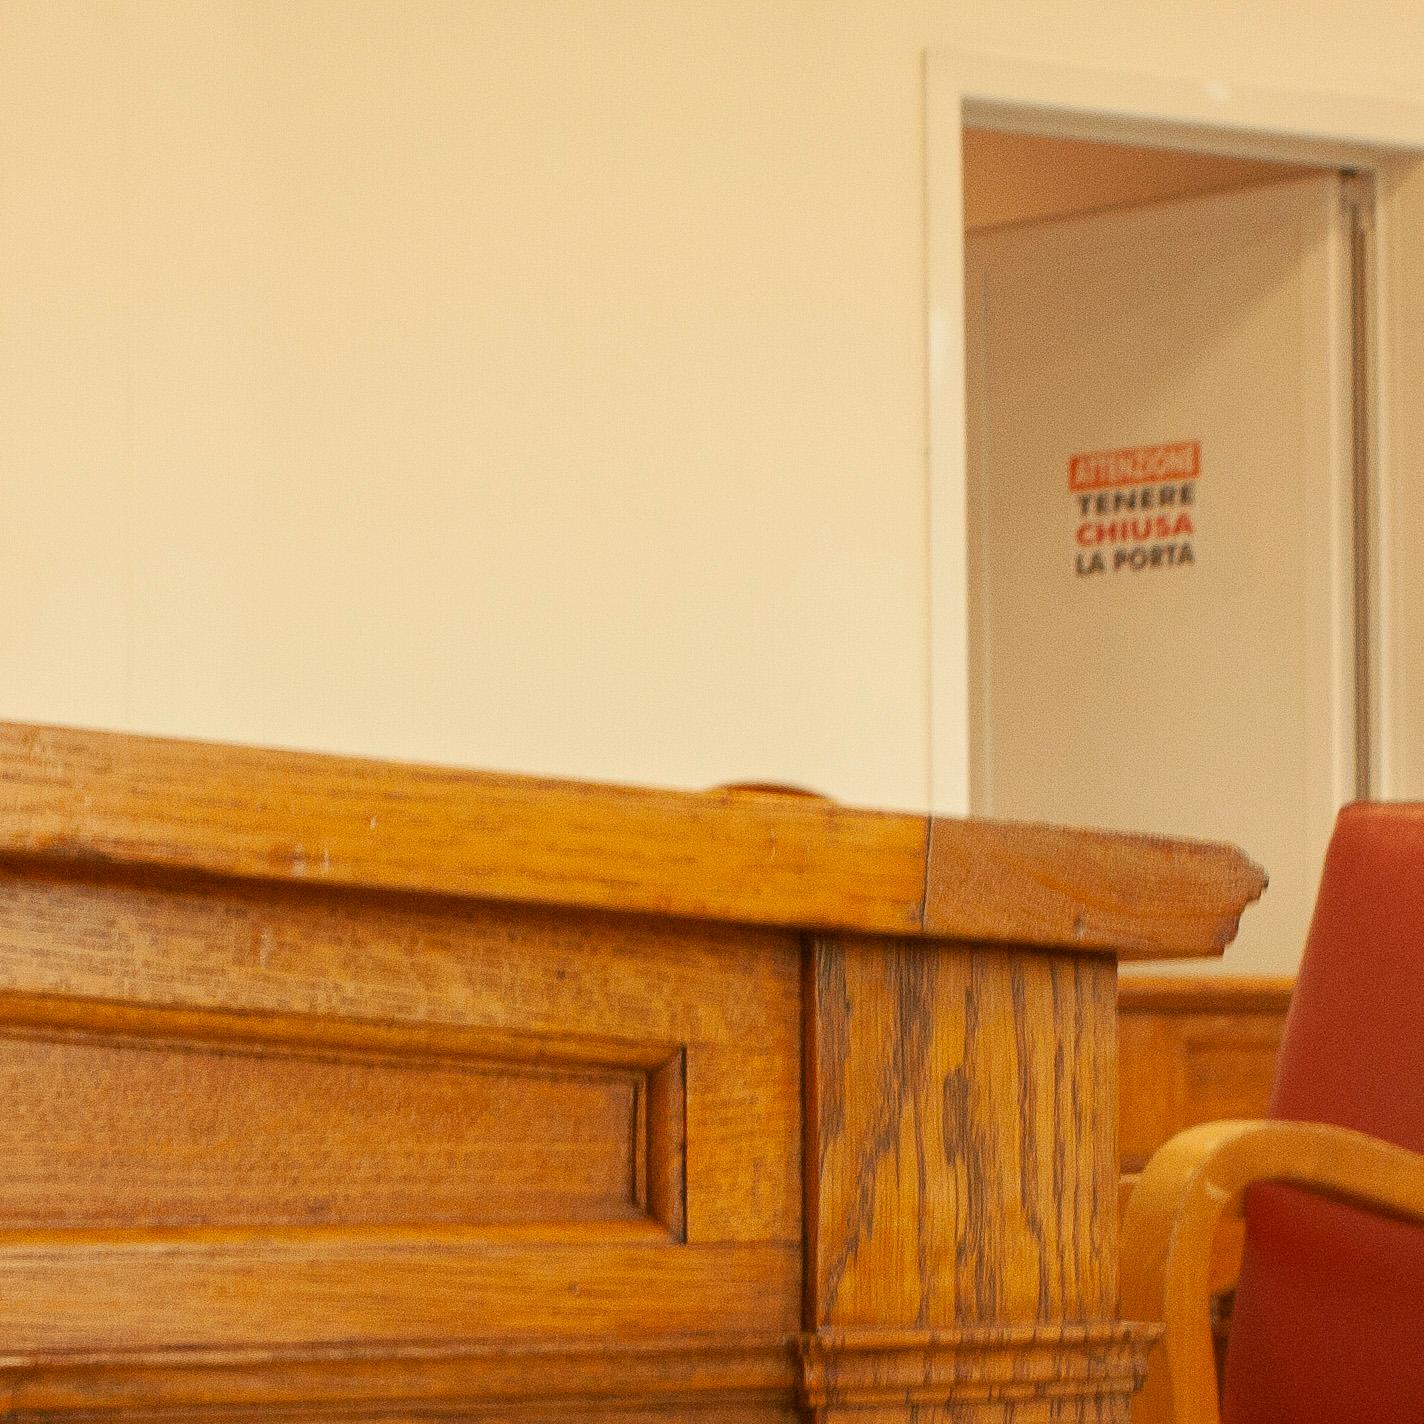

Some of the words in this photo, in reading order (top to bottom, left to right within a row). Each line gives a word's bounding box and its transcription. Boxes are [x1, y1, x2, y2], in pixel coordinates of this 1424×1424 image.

[1075, 449, 1194, 484] ATTENZIONE
[1079, 481, 1195, 515] TENERE
[1076, 512, 1193, 547] CHIUSA
[1076, 549, 1105, 576] LA
[1113, 542, 1194, 572] PORTA
